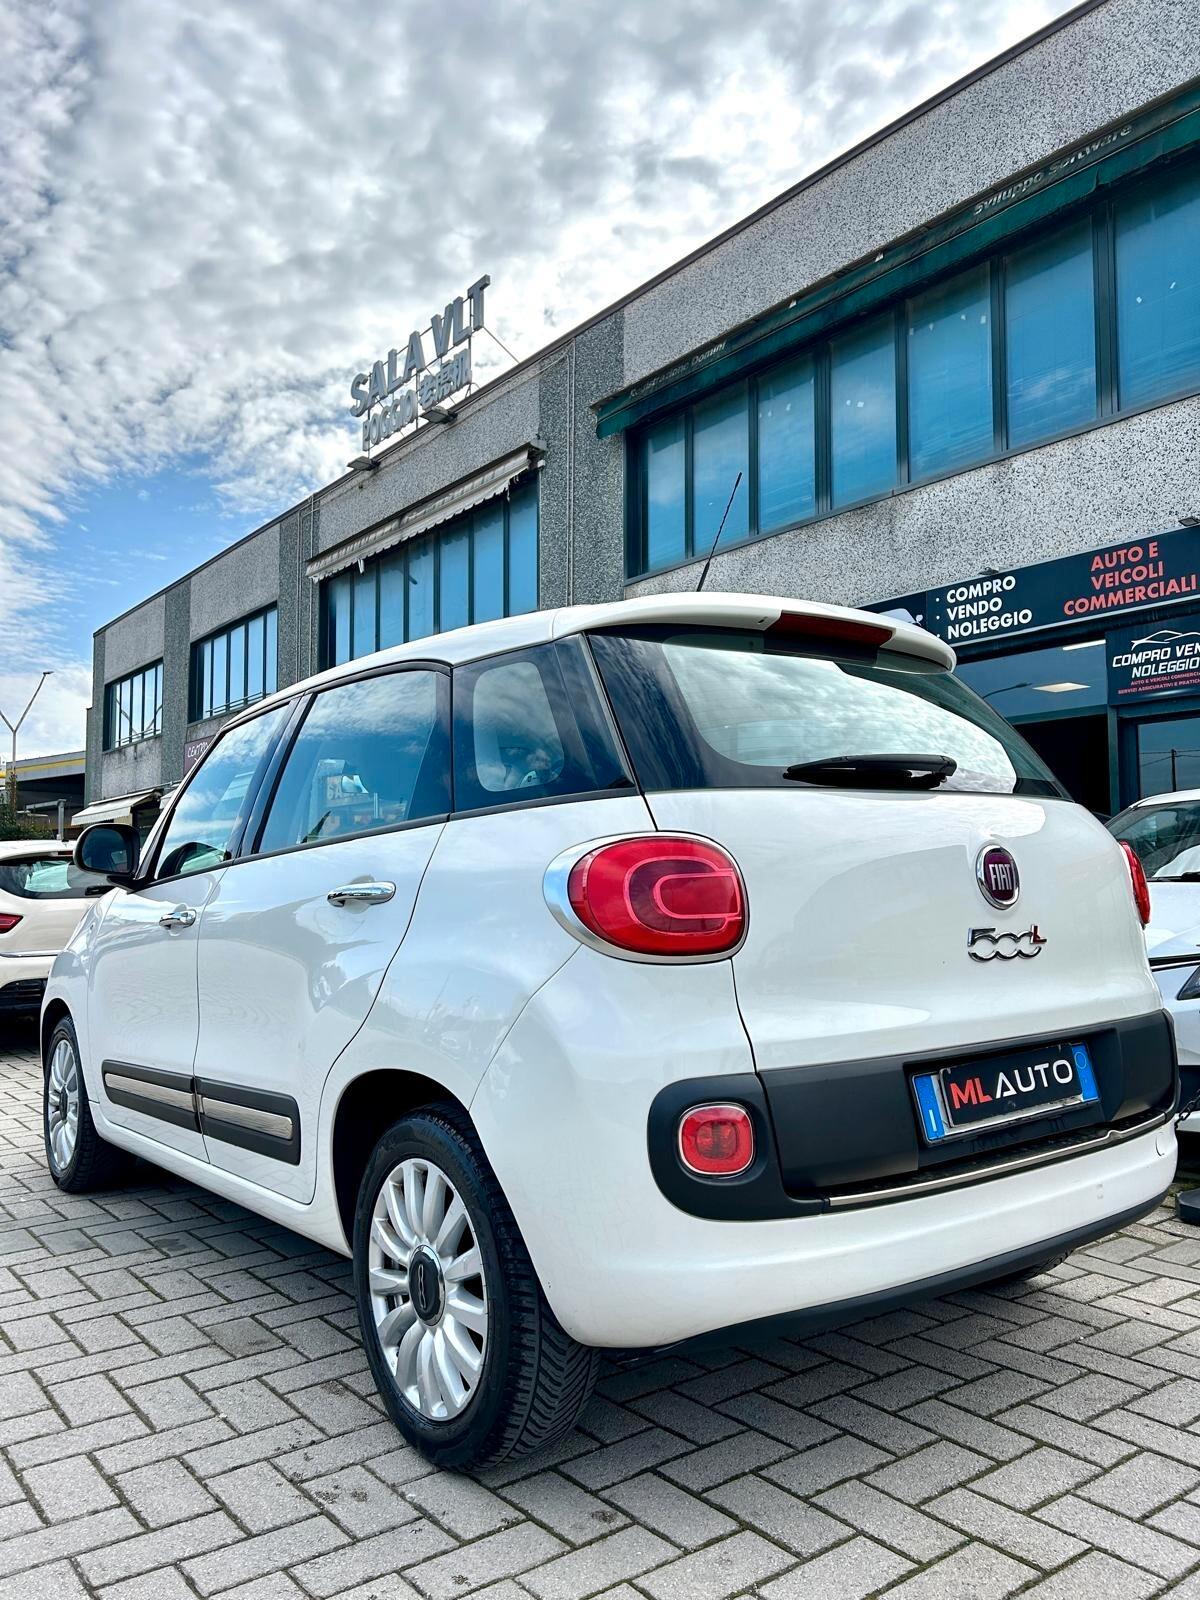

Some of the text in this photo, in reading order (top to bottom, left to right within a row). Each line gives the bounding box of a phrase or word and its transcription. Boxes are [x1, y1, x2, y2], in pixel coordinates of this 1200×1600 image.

[350, 274, 491, 418] SALA VLT
[362, 389, 419, 452] POGGIO
[1091, 541, 1159, 572] AUTO E
[946, 575, 1016, 604] COMPRO
[1091, 560, 1164, 590] VEICOLI
[946, 597, 1003, 621] VENDO
[1063, 574, 1198, 616] COMMERCIALI
[947, 608, 1033, 640] NOLEGGIO
[1112, 647, 1172, 668] COMPRO
[1131, 656, 1200, 679] NOLEGGIO
[988, 863, 1013, 891] FIAT
[950, 1059, 1074, 1109] ML AUTO
